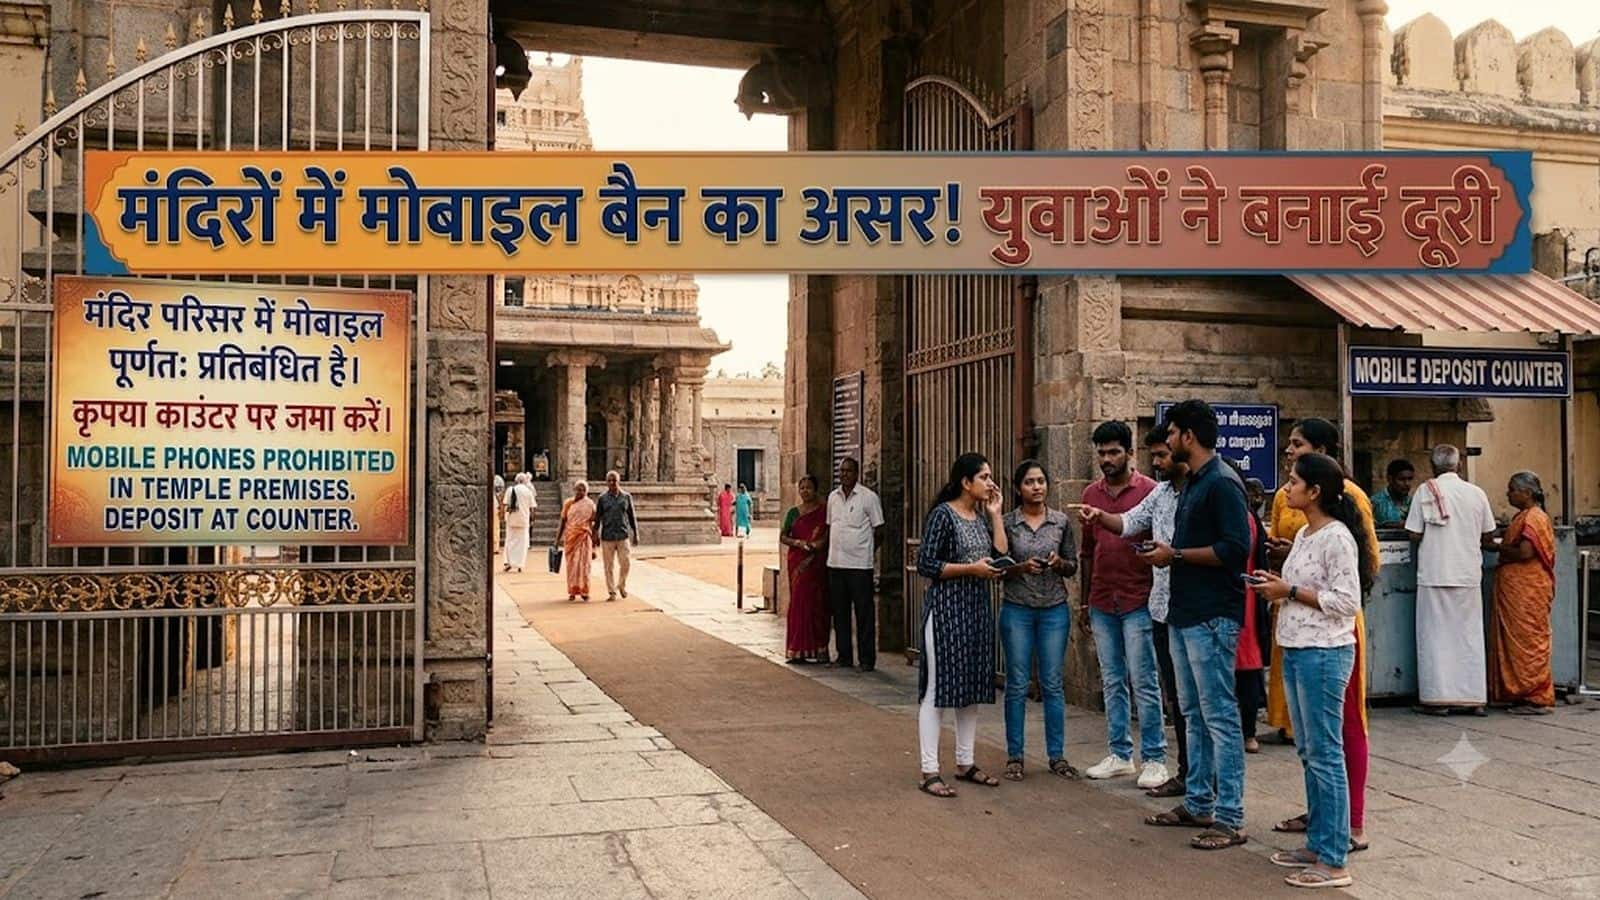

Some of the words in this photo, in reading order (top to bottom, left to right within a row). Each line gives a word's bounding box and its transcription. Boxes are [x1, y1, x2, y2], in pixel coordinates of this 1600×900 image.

[84, 292, 152, 332] मंदिर
[161, 296, 246, 333] परिसर
[254, 297, 277, 335] में
[283, 299, 385, 344] मोबाइल
[198, 343, 321, 383] प्रतिबंधित
[329, 345, 360, 388] है।
[1355, 357, 1417, 384] MOBILE
[1421, 358, 1487, 386] DEPOSIT
[1491, 361, 1564, 388] COUNTER
[72, 400, 147, 438] कृपया
[156, 395, 239, 431] काउंटर
[246, 404, 278, 431] पर
[285, 405, 336, 433] जमा
[343, 398, 392, 433] करें।
[67, 445, 156, 469] MOBILE
[163, 446, 256, 471] PHONES
[263, 449, 396, 473] PROHIBITED
[109, 477, 133, 499] IN
[141, 477, 231, 500] TEMPLE
[239, 479, 356, 502] PREMISES.
[105, 508, 203, 530] DEPOSIT
[210, 508, 239, 531] AT
[246, 508, 359, 531] COUNTER.
